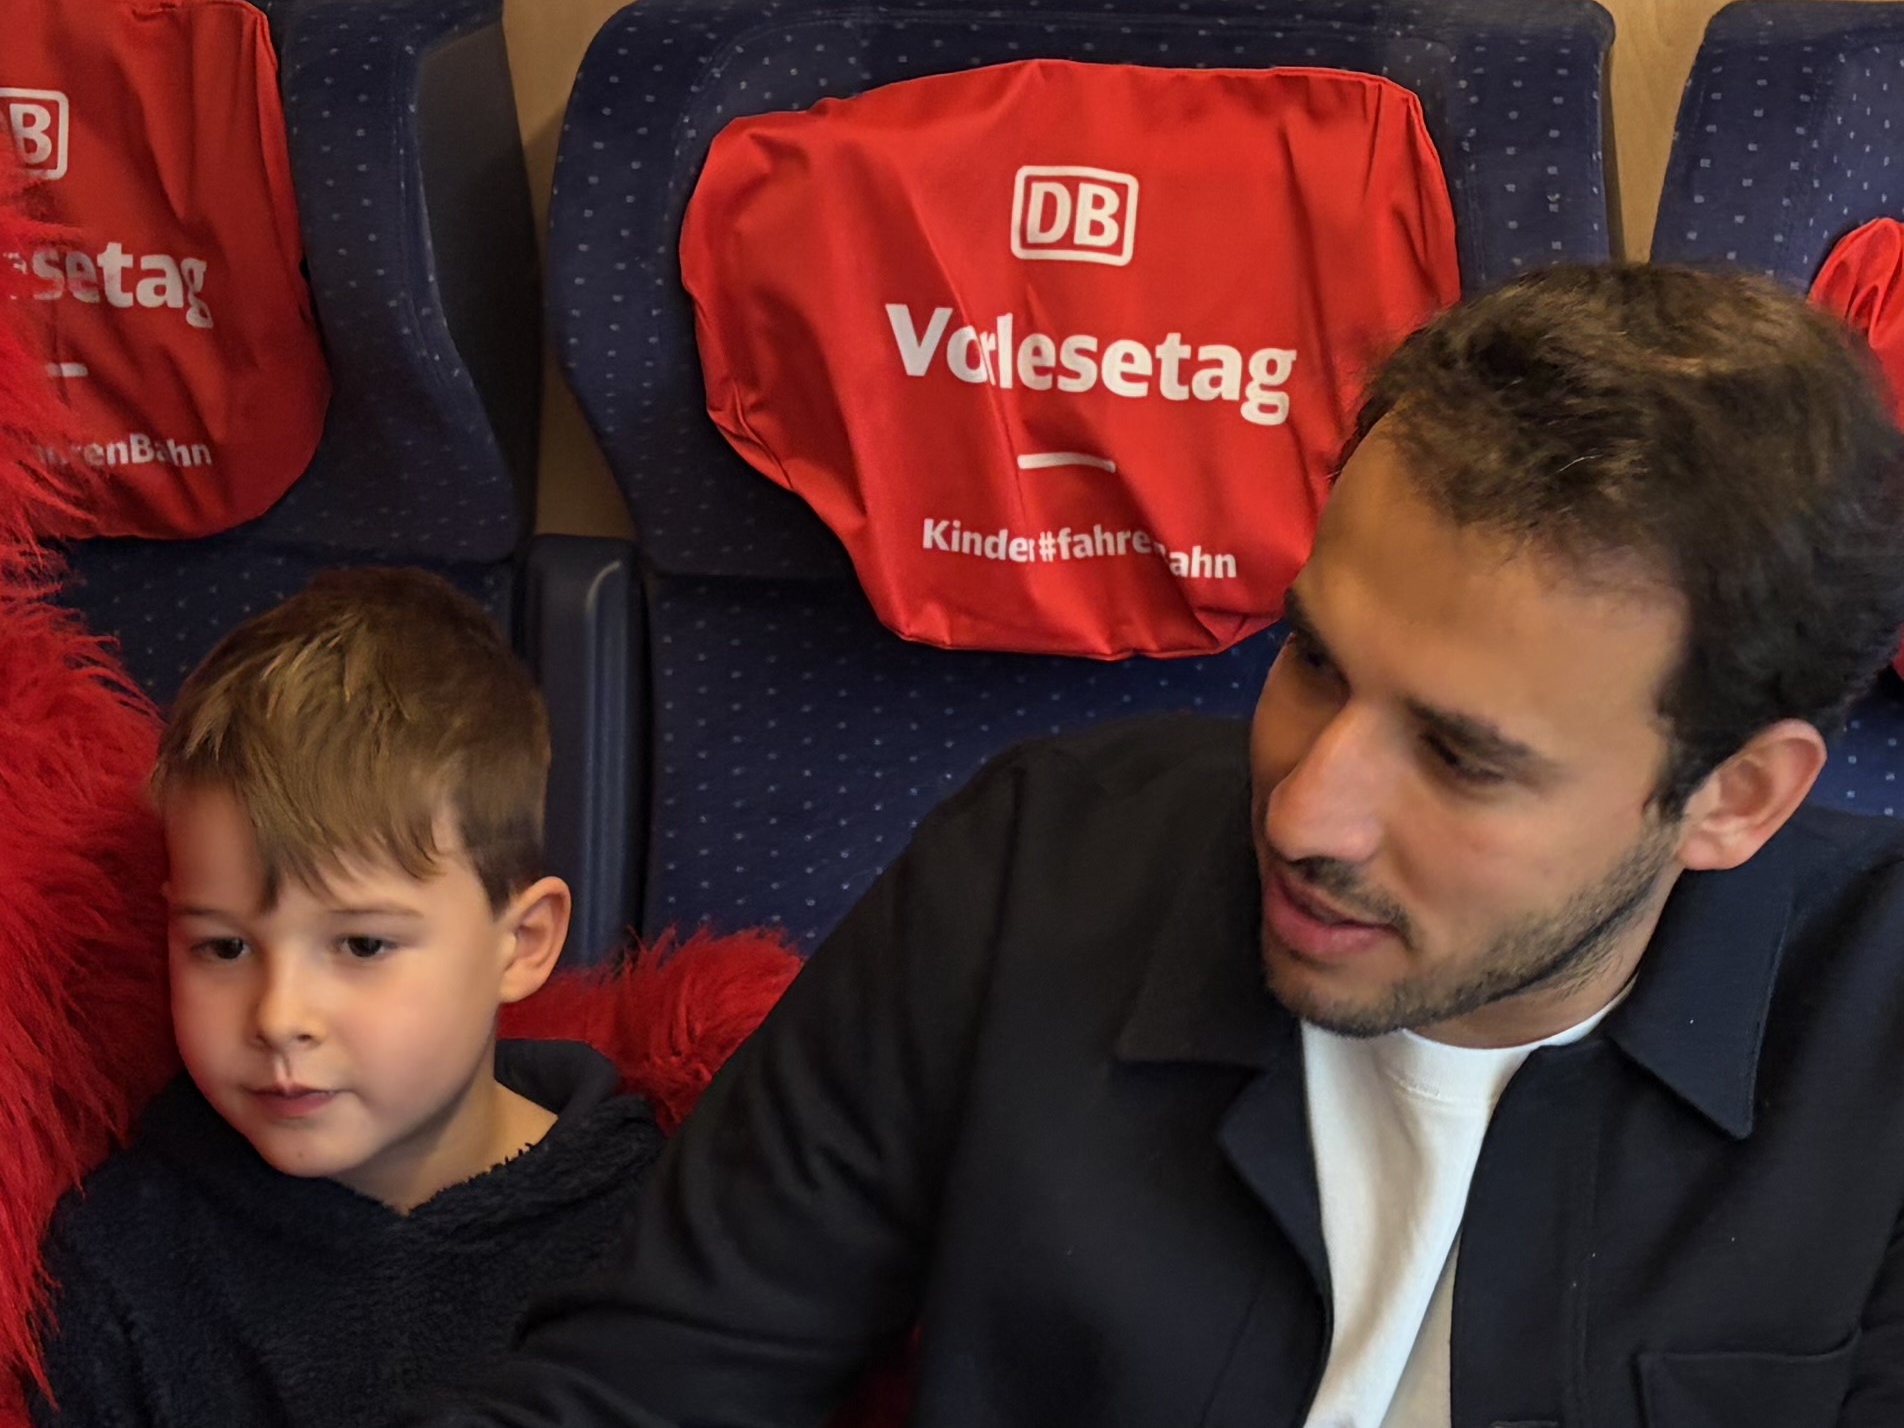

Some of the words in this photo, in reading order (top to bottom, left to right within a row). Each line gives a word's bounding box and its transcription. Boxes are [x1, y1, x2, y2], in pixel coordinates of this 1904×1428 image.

[1027, 182, 1120, 249] DB
[4, 242, 214, 329] setag
[1038, 524, 1237, 579] #fahreahn
